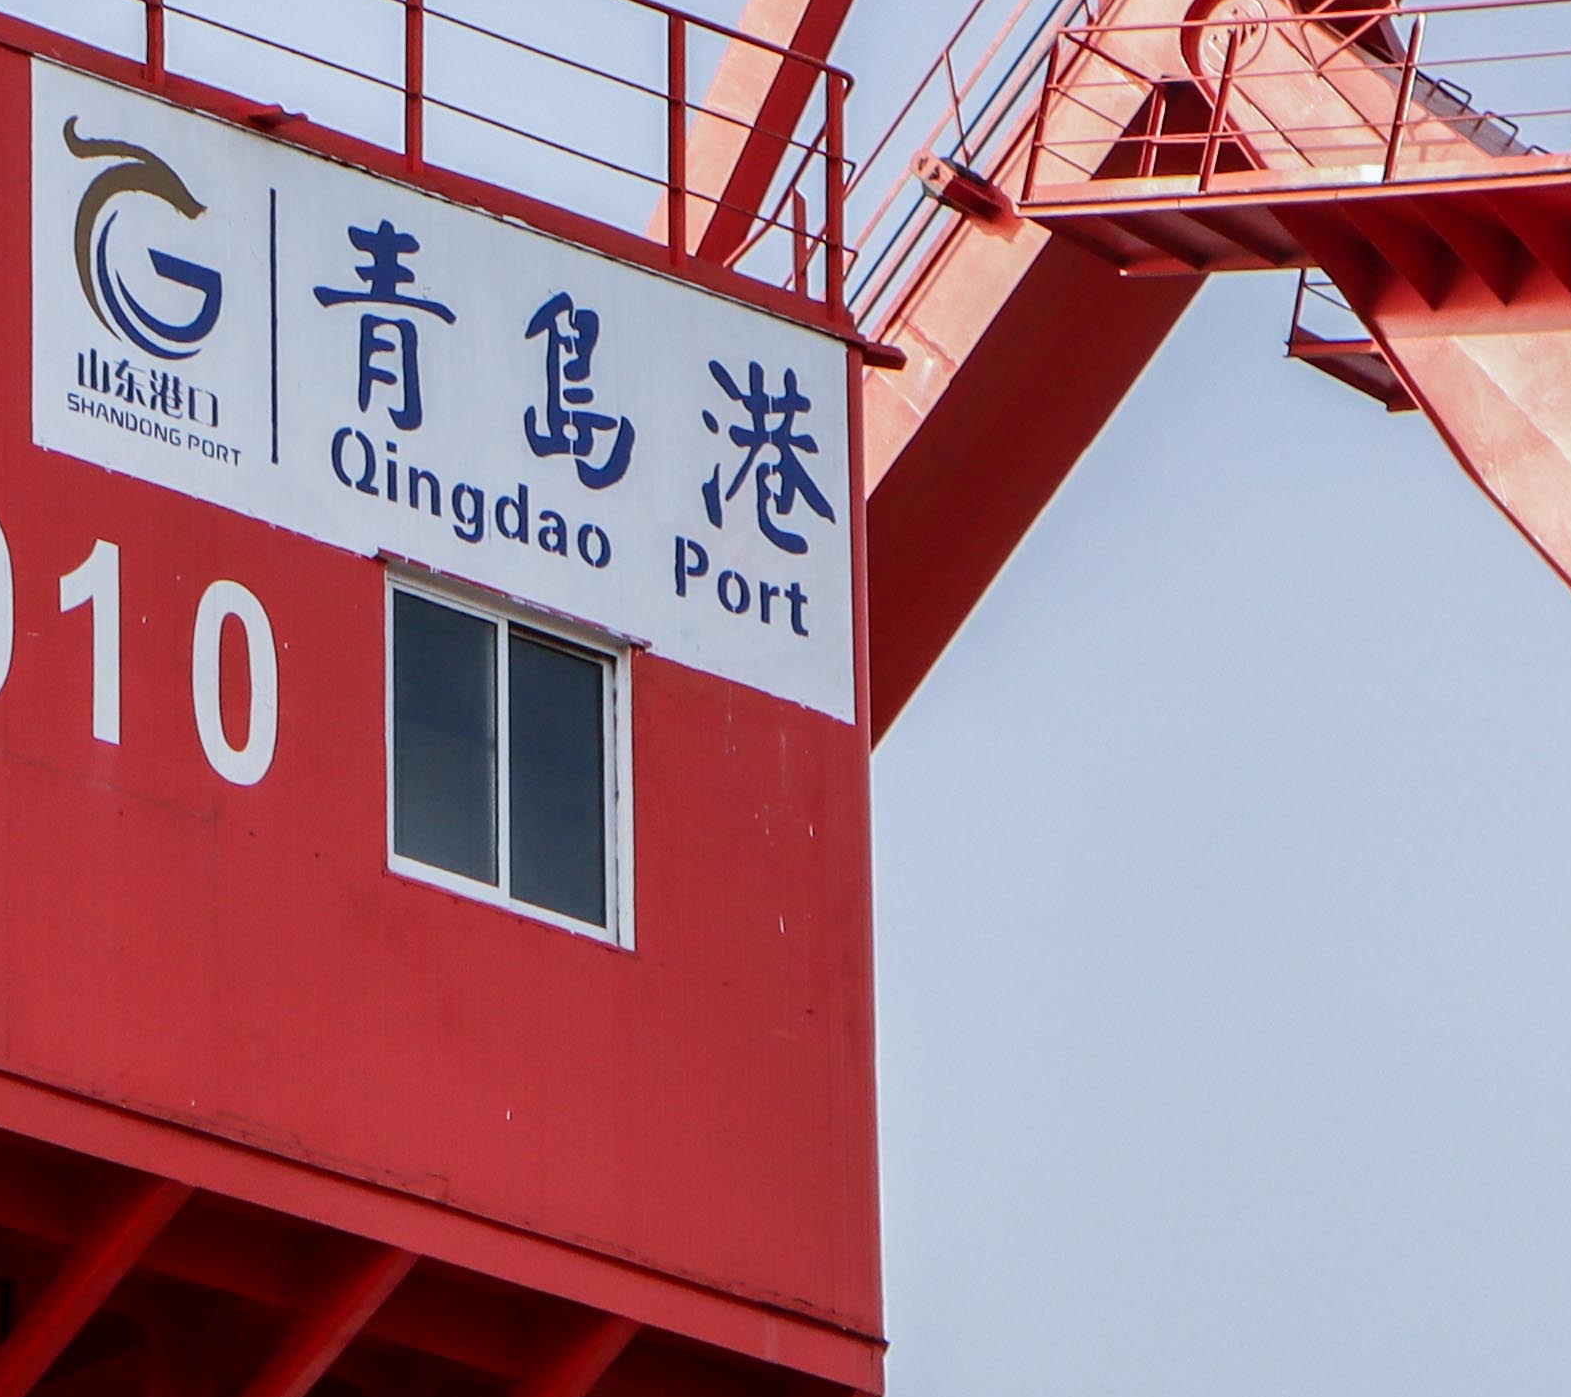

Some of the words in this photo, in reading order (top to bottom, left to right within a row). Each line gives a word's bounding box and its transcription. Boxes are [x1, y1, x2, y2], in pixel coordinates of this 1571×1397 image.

[67, 392, 182, 446] SHANDONG
[188, 433, 242, 467] PORT
[77, 347, 219, 428] 山东港口
[313, 219, 836, 555] 青島港
[330, 426, 612, 569] Qingdao
[674, 535, 809, 638] Port
